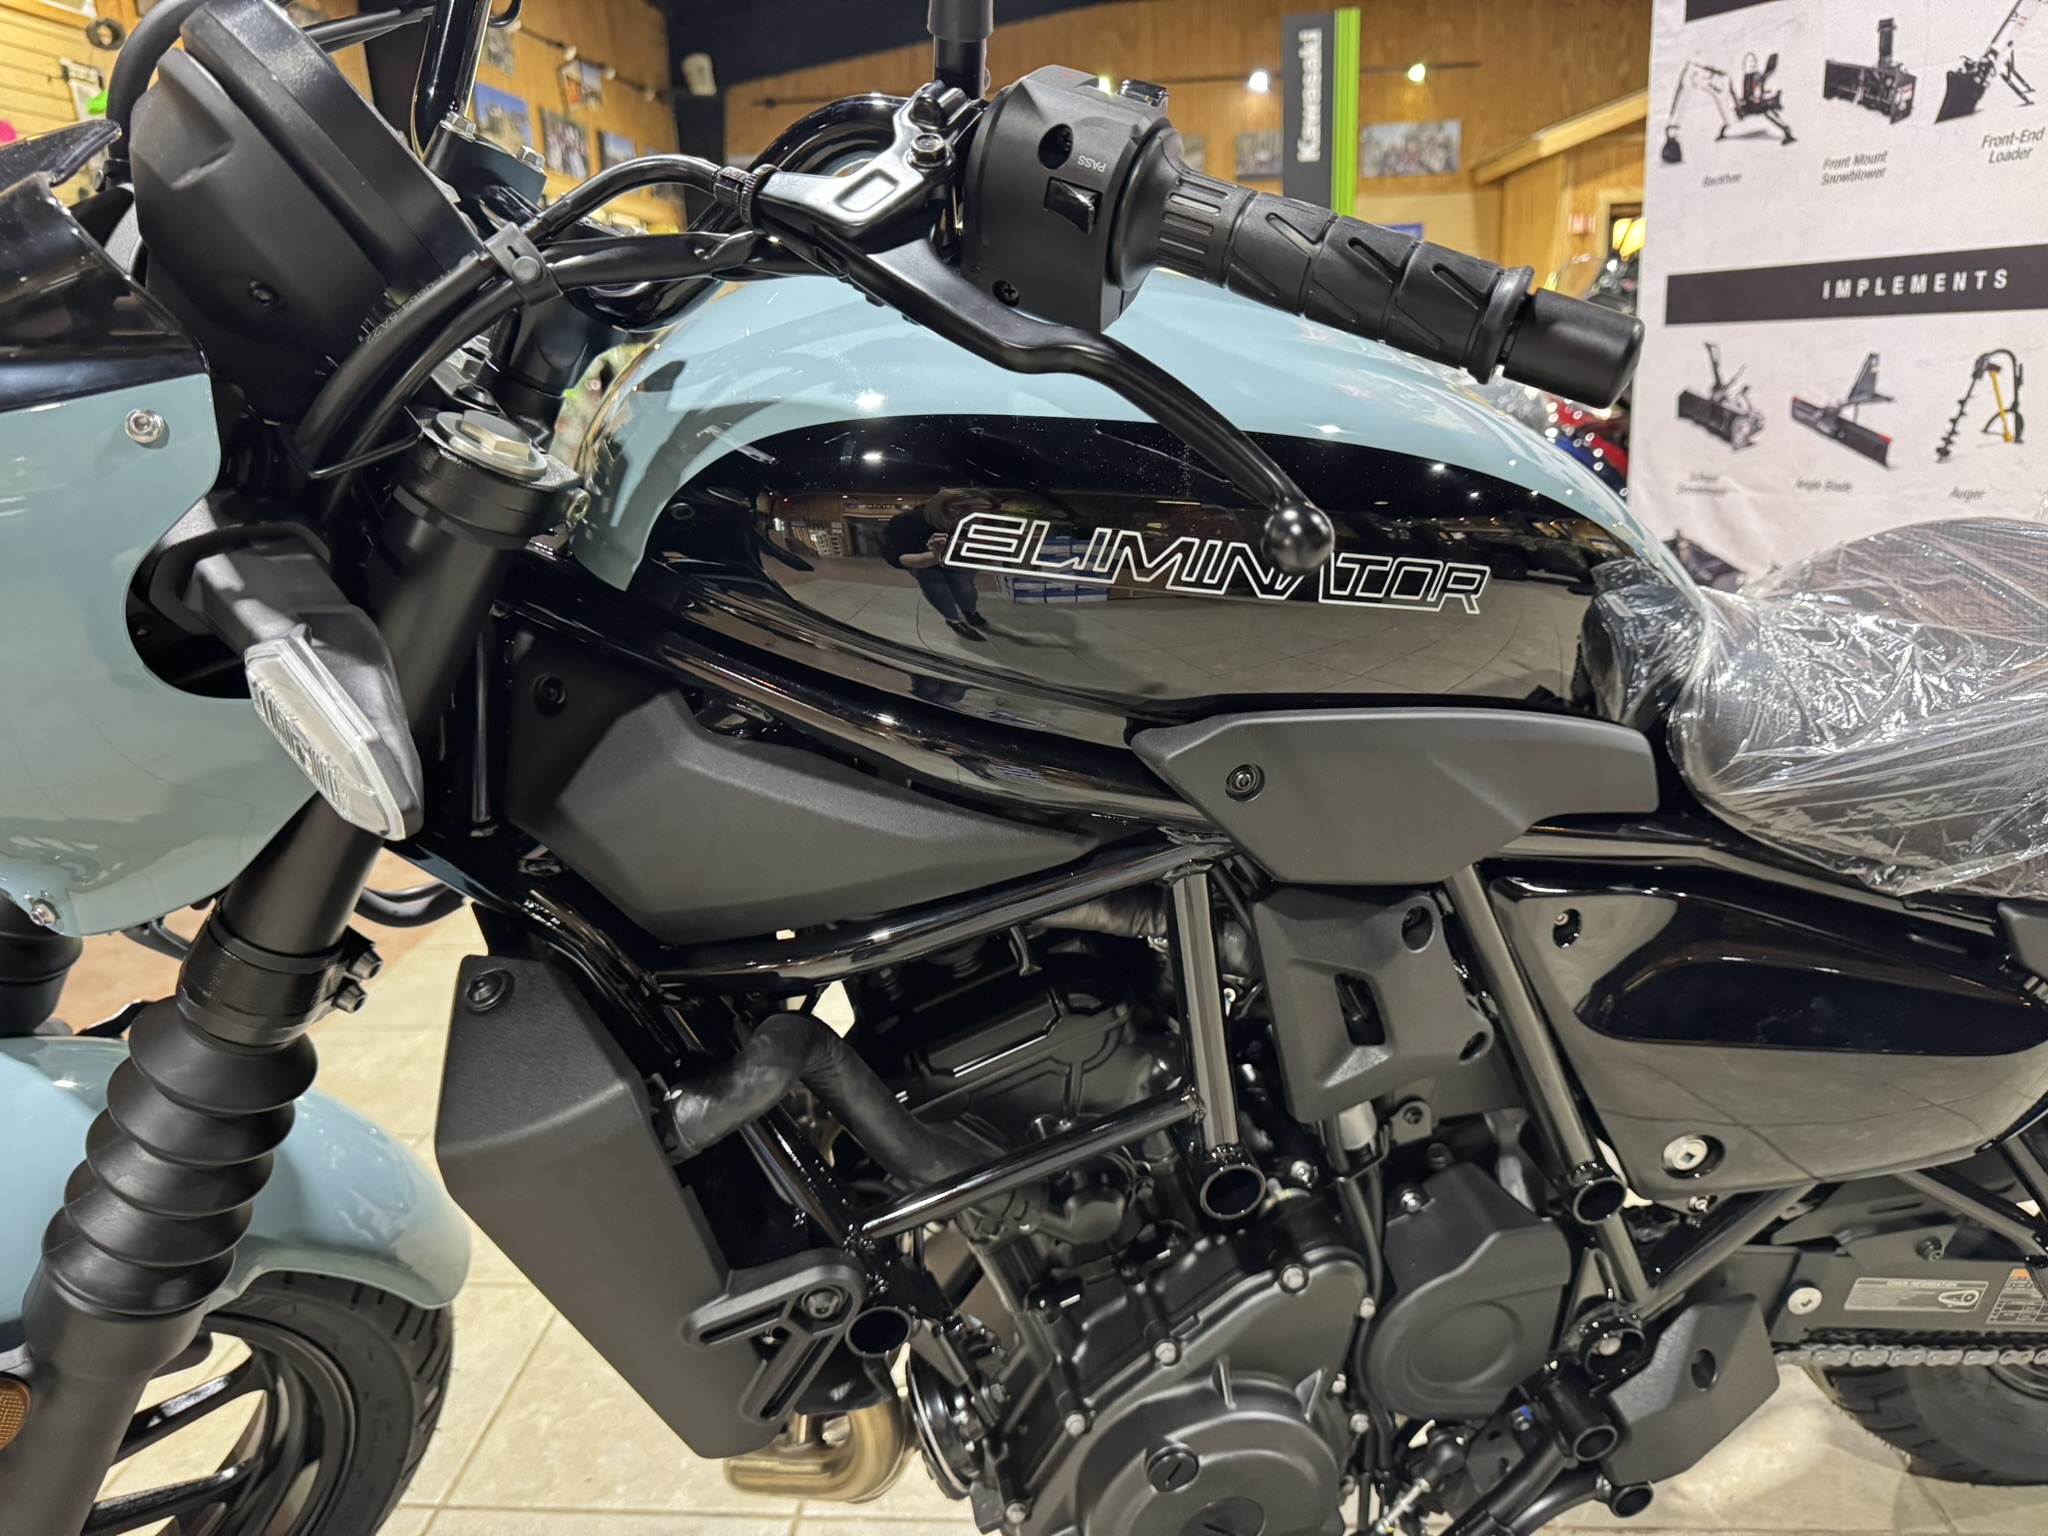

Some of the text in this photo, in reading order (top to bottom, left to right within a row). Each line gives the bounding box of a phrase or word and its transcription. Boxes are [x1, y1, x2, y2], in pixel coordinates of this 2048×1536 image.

[1297, 27, 1322, 162] Kawasaki
[1981, 126, 2046, 149] Front-End
[1077, 155, 1107, 173] PASS
[1988, 147, 2033, 164] Loader
[1822, 269, 2008, 300] IMPLEMENTS
